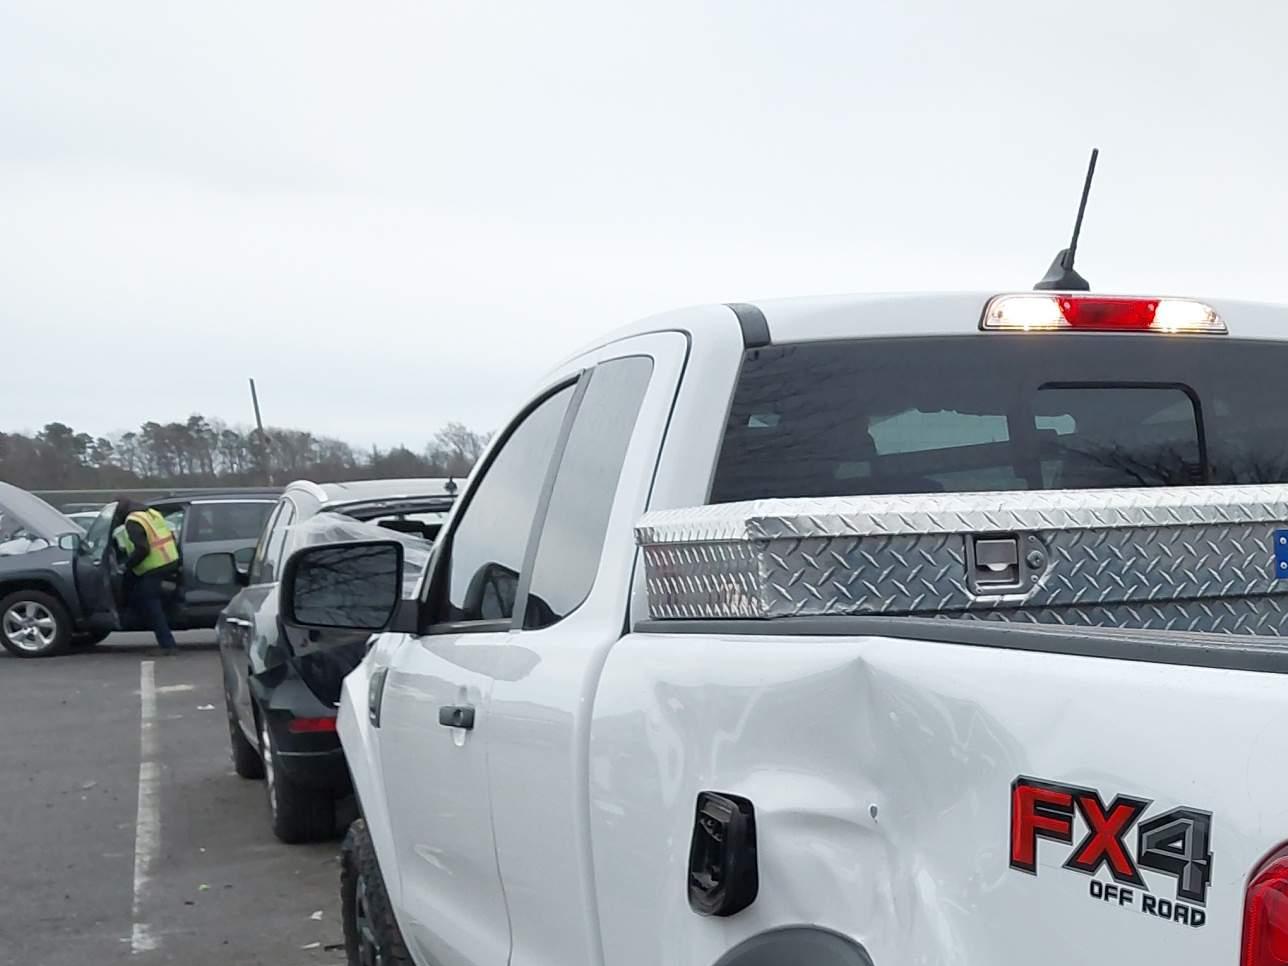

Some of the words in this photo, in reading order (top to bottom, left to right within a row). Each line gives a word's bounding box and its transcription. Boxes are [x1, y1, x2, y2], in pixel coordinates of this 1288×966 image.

[1009, 774, 1214, 908] FX4
[1090, 880, 1133, 907] OFF
[1142, 895, 1206, 927] ROAD
